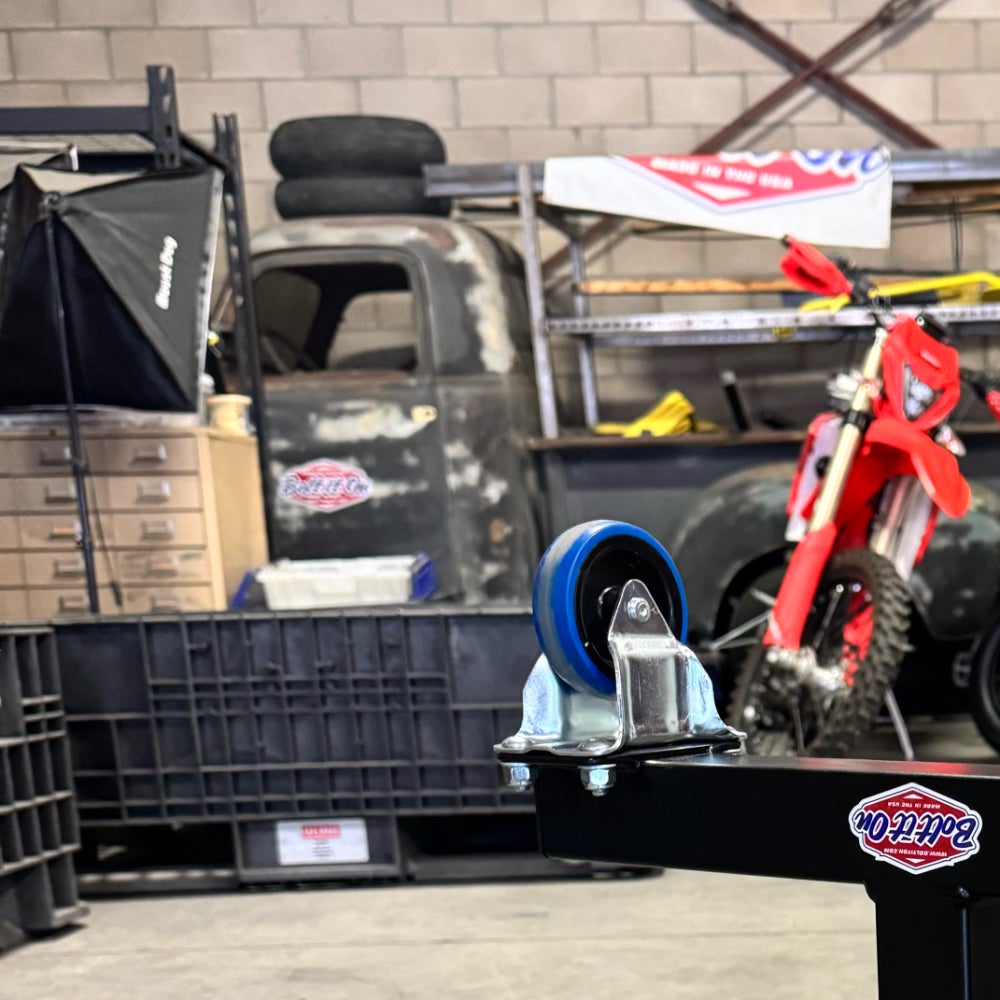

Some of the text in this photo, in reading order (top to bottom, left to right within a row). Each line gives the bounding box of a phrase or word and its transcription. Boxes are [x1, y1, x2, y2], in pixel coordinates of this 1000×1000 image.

[650, 156, 794, 190] MADE IN THE USA
[281, 474, 322, 496] Bolt
[854, 811, 977, 849] Bolt it On
